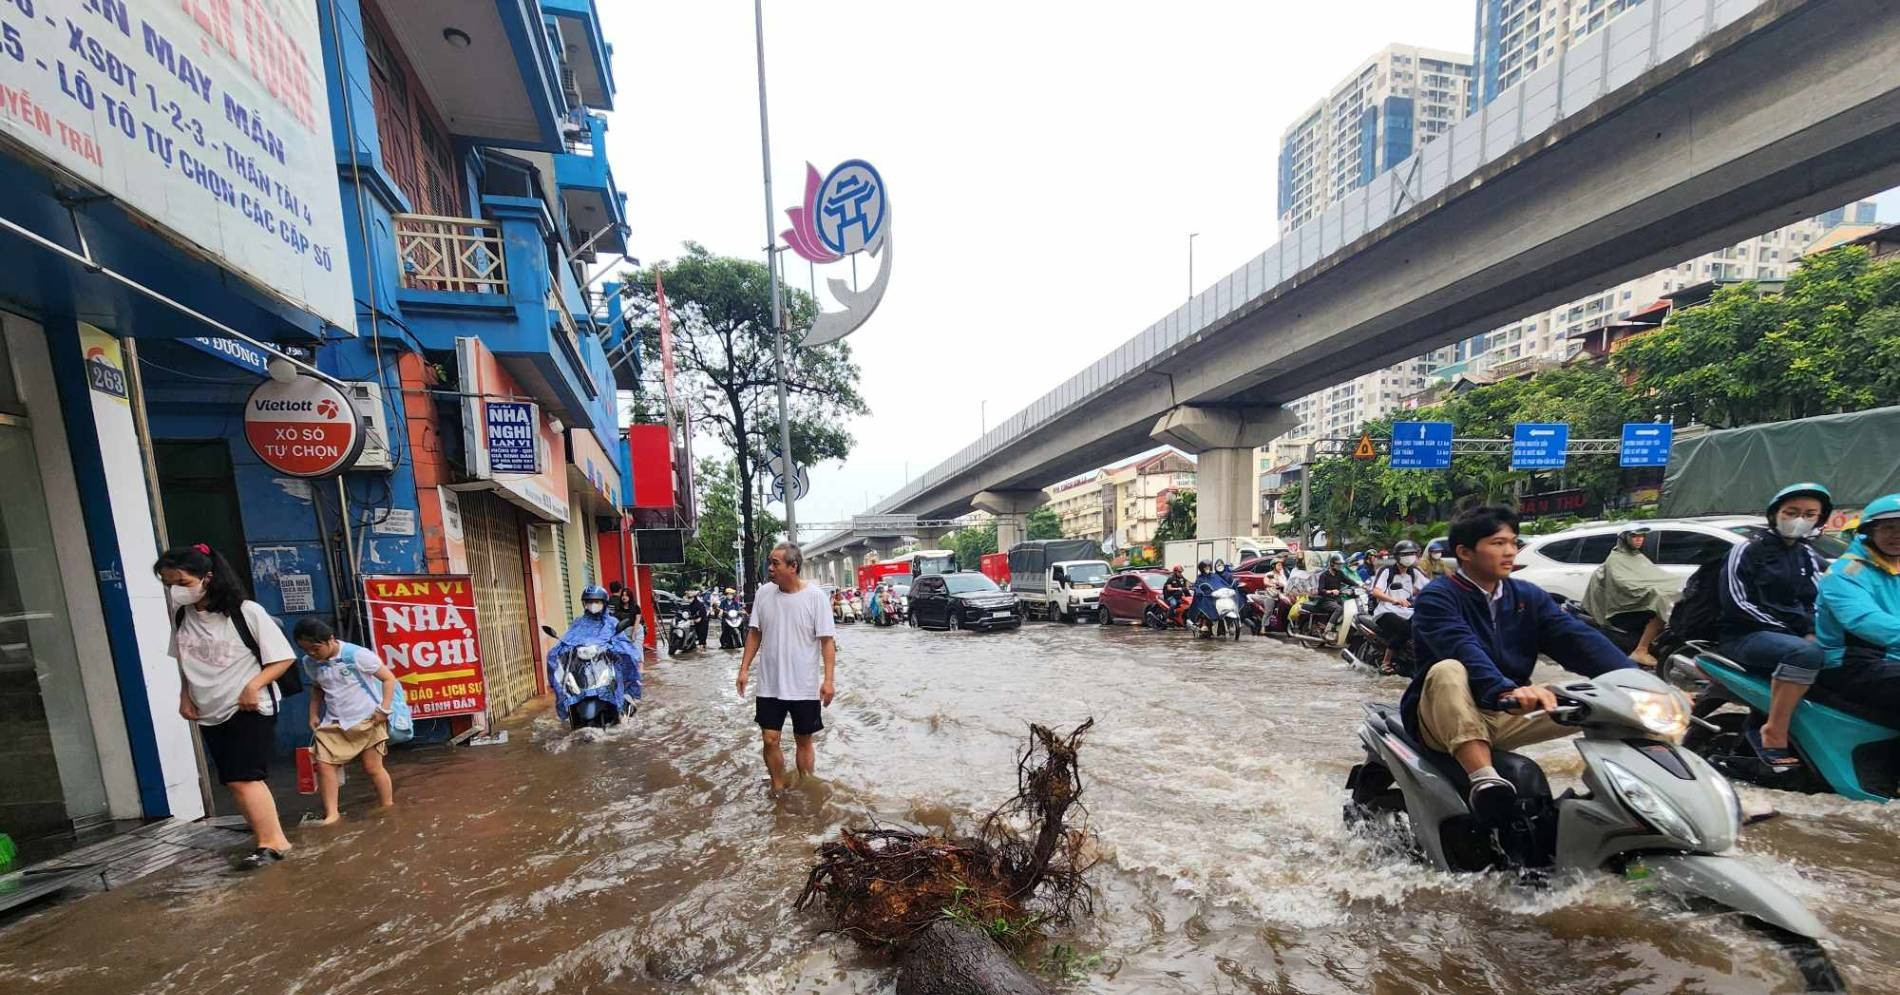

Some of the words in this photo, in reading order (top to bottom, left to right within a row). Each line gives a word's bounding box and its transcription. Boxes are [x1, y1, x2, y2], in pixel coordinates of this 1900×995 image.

[142, 20, 212, 104] MAY
[223, 92, 286, 165] MẮN
[56, 119, 104, 168] TRÃI
[146, 83, 205, 147] 1-2-3
[223, 141, 271, 197] THẦN
[274, 181, 300, 217] TÀI
[303, 204, 312, 226] 4
[57, 59, 96, 111] LÔ
[101, 92, 136, 139] TÔ
[141, 121, 174, 169] TỰ
[178, 149, 236, 208] CHỌN
[241, 192, 275, 234] CÁC
[279, 219, 309, 255] CẶP
[313, 244, 333, 272] SỐ
[93, 366, 123, 393] 263
[255, 399, 313, 411] Vietlott
[489, 406, 529, 422] NHÀ
[488, 423, 532, 439] NGHỈ
[264, 445, 288, 460] TỰ
[292, 445, 338, 460] CHỌN
[376, 582, 430, 597] LAN
[437, 581, 464, 594] VI
[382, 596, 468, 634] NHÀ
[381, 628, 479, 670] NGHỈ
[442, 684, 466, 699] LỊCH
[468, 682, 483, 696] SỰ
[423, 701, 451, 713] BÌNH
